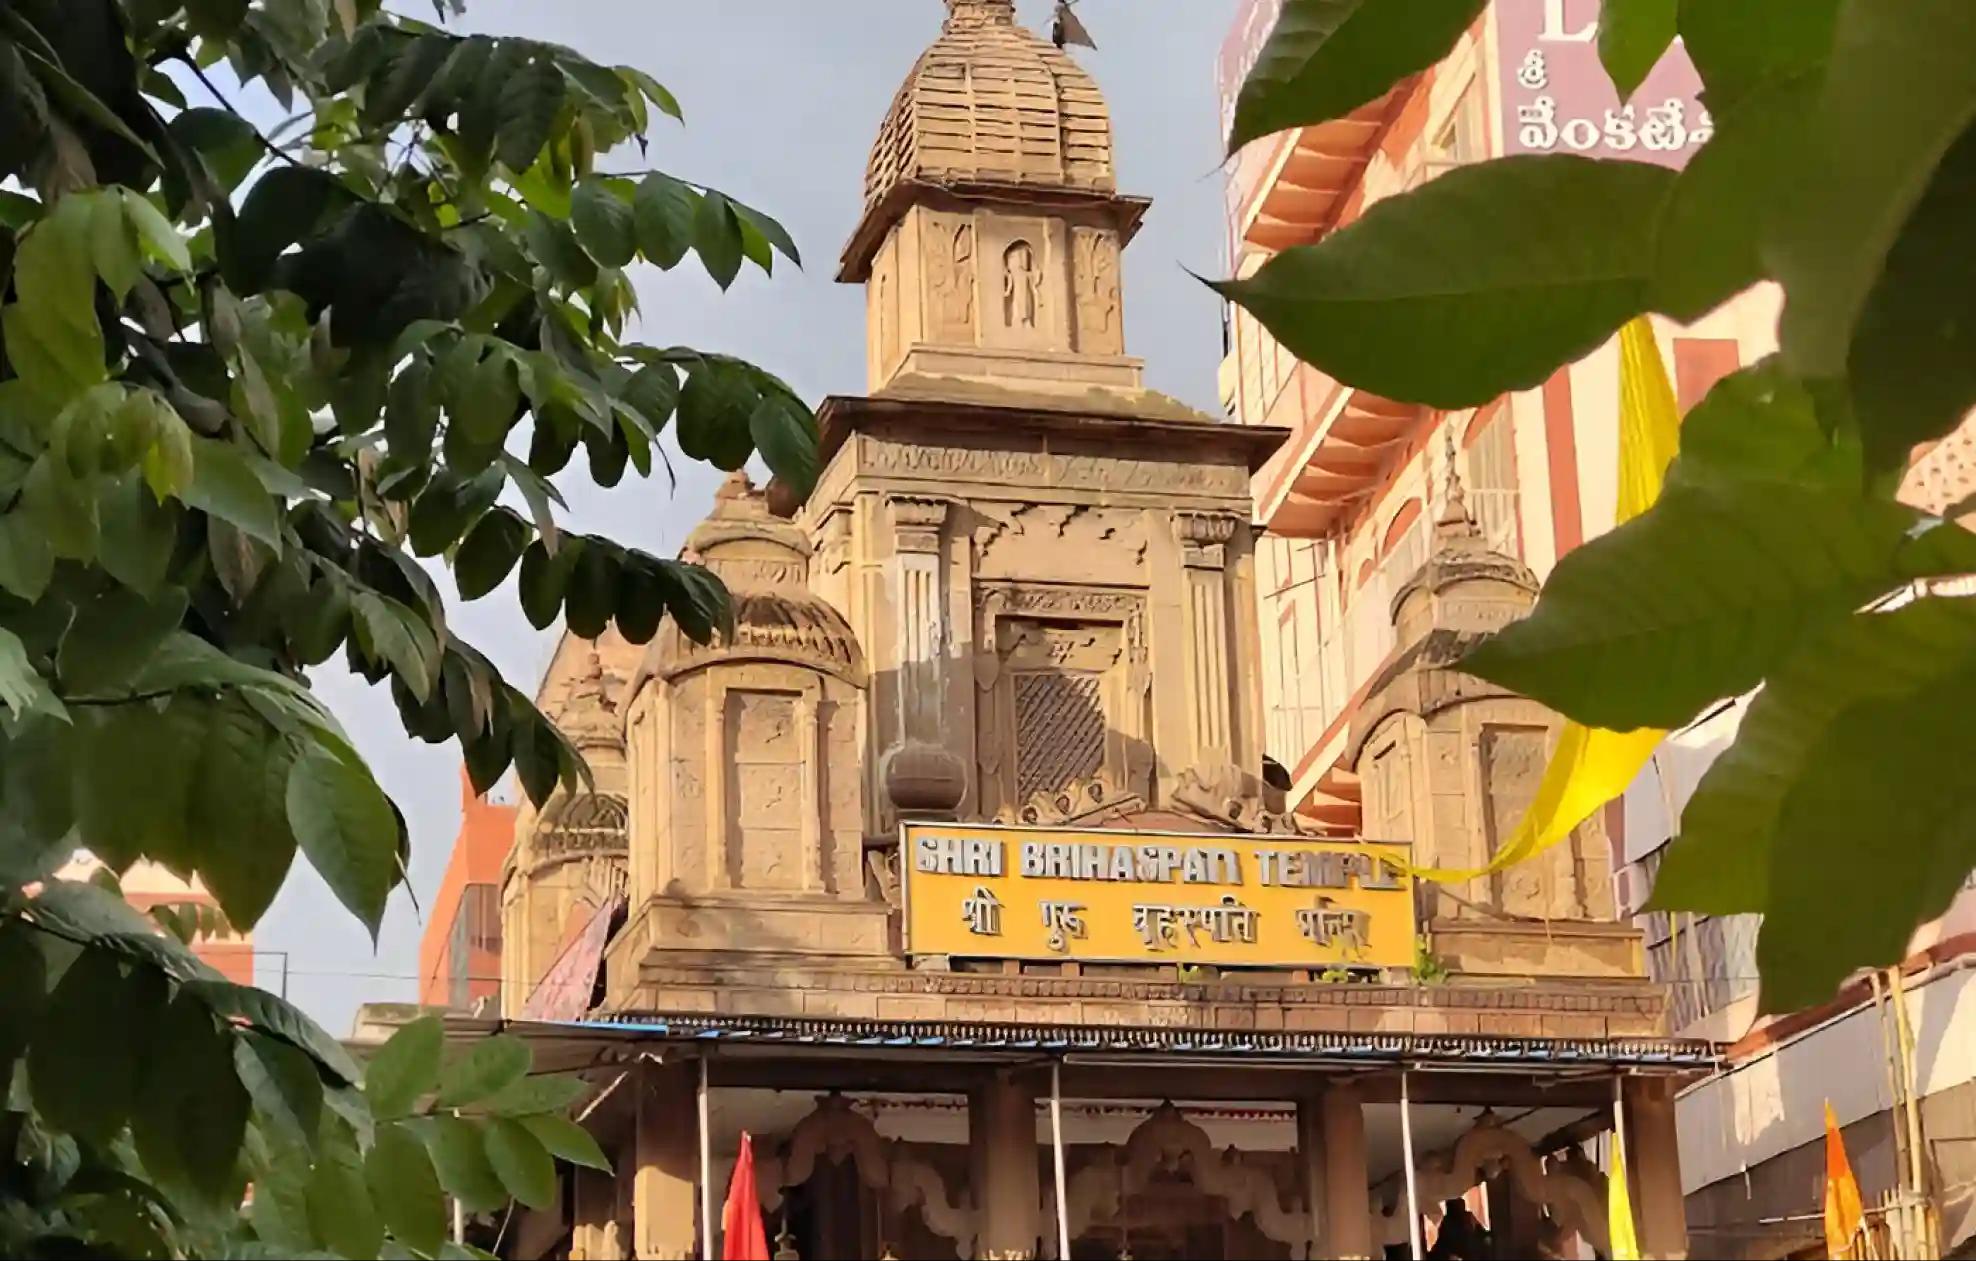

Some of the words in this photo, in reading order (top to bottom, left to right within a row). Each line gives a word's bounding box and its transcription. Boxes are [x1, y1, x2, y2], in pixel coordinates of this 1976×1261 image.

[1537, 0, 1598, 42] L
[916, 838, 1005, 876] SHRI
[1021, 842, 1243, 885] BRIHASPATI
[962, 886, 1002, 934] श्री
